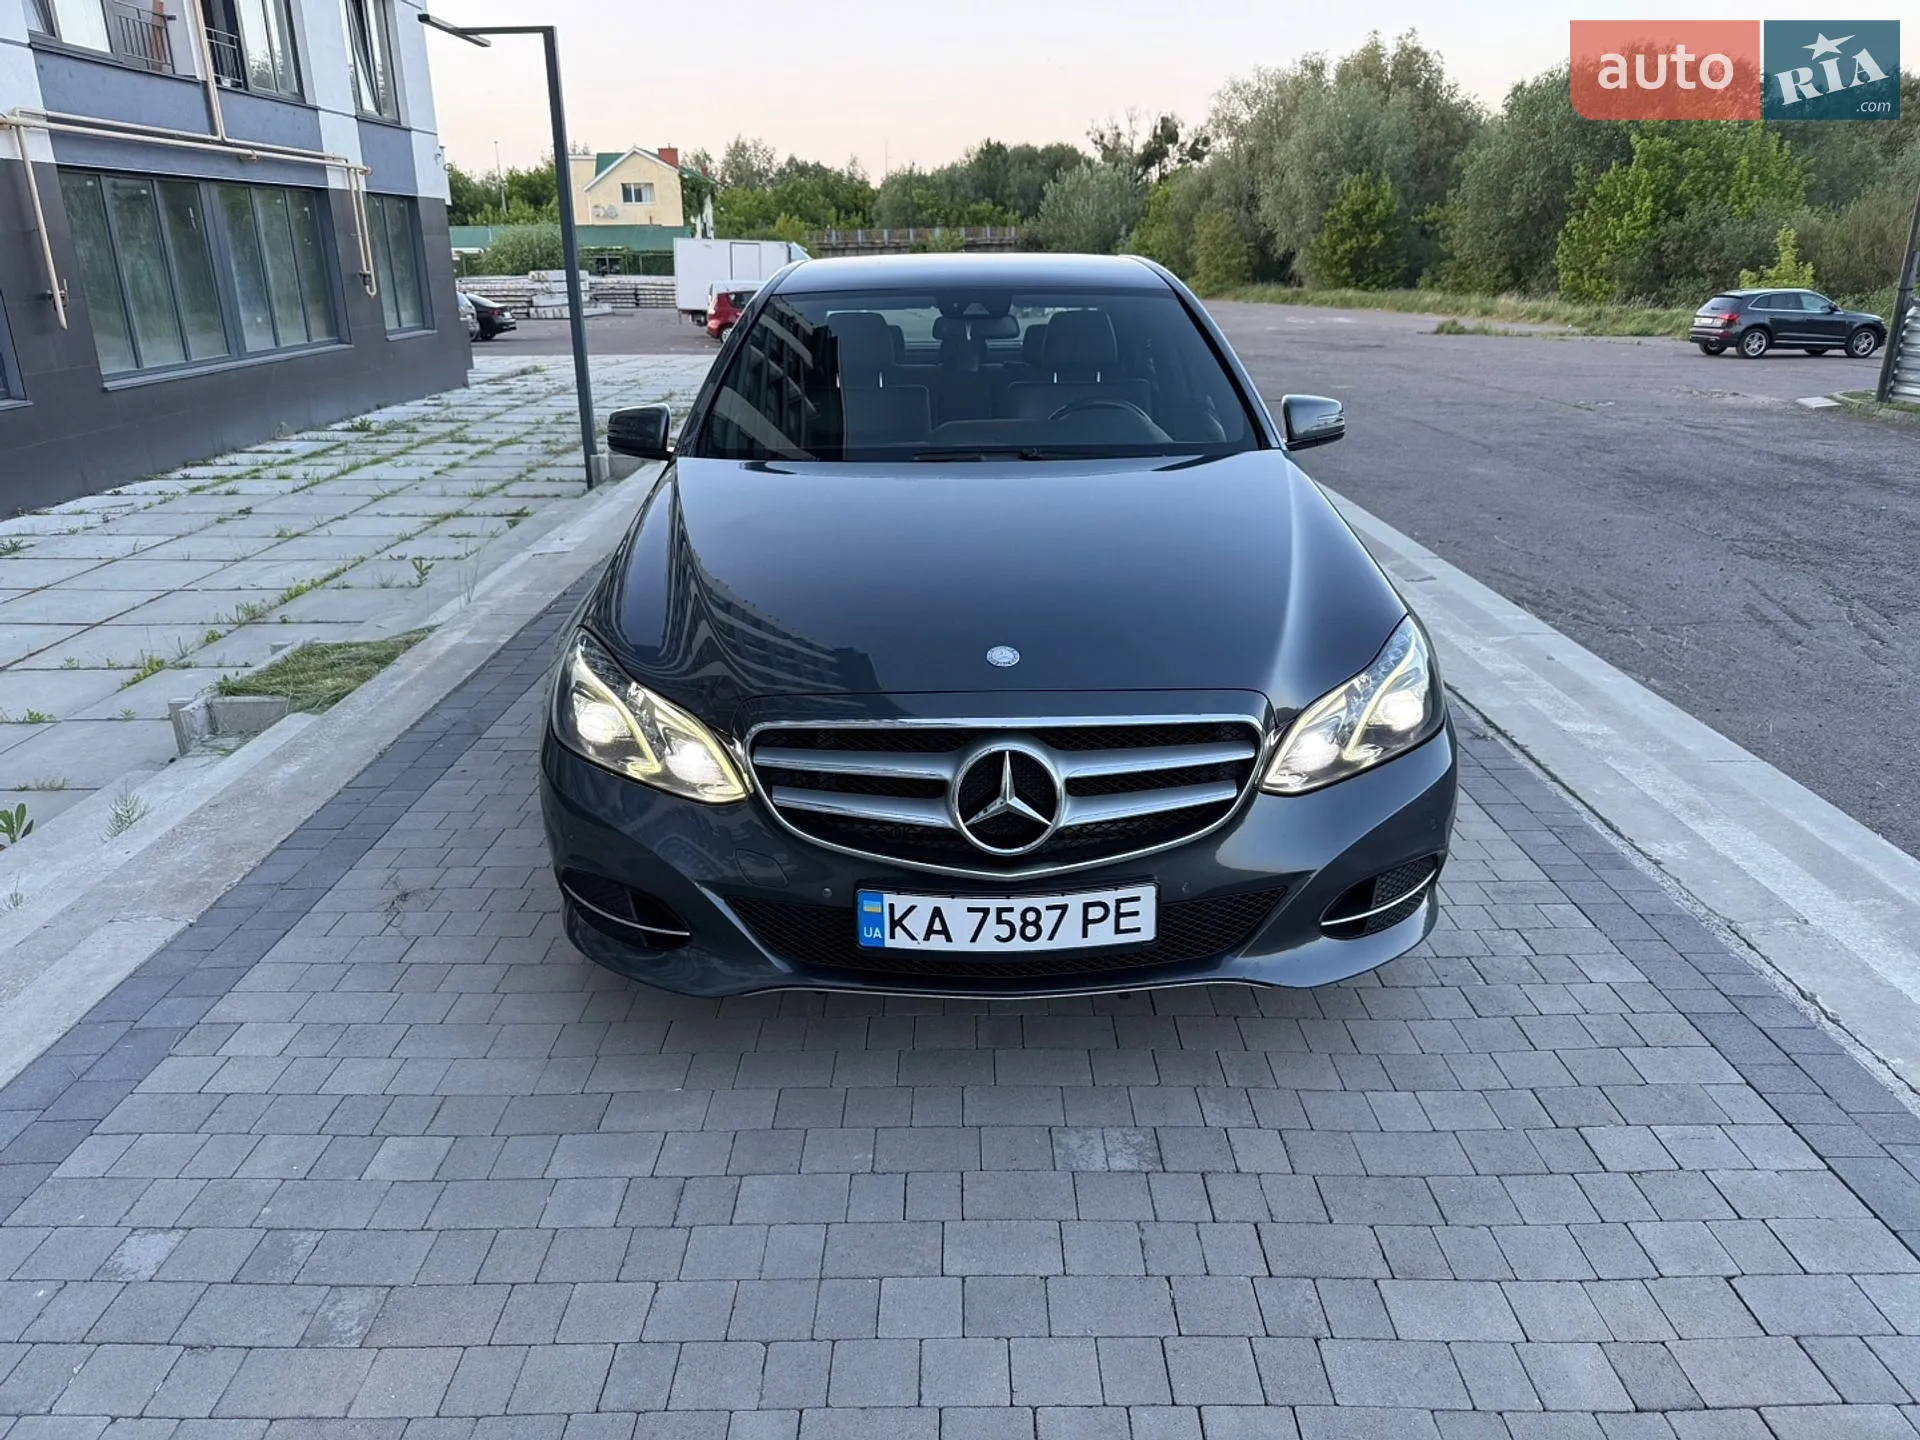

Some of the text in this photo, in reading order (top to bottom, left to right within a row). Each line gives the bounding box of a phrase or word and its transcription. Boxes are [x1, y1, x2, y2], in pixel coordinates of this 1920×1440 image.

[863, 926, 883, 939] UA
[888, 896, 1142, 943] KA 7587 PE
